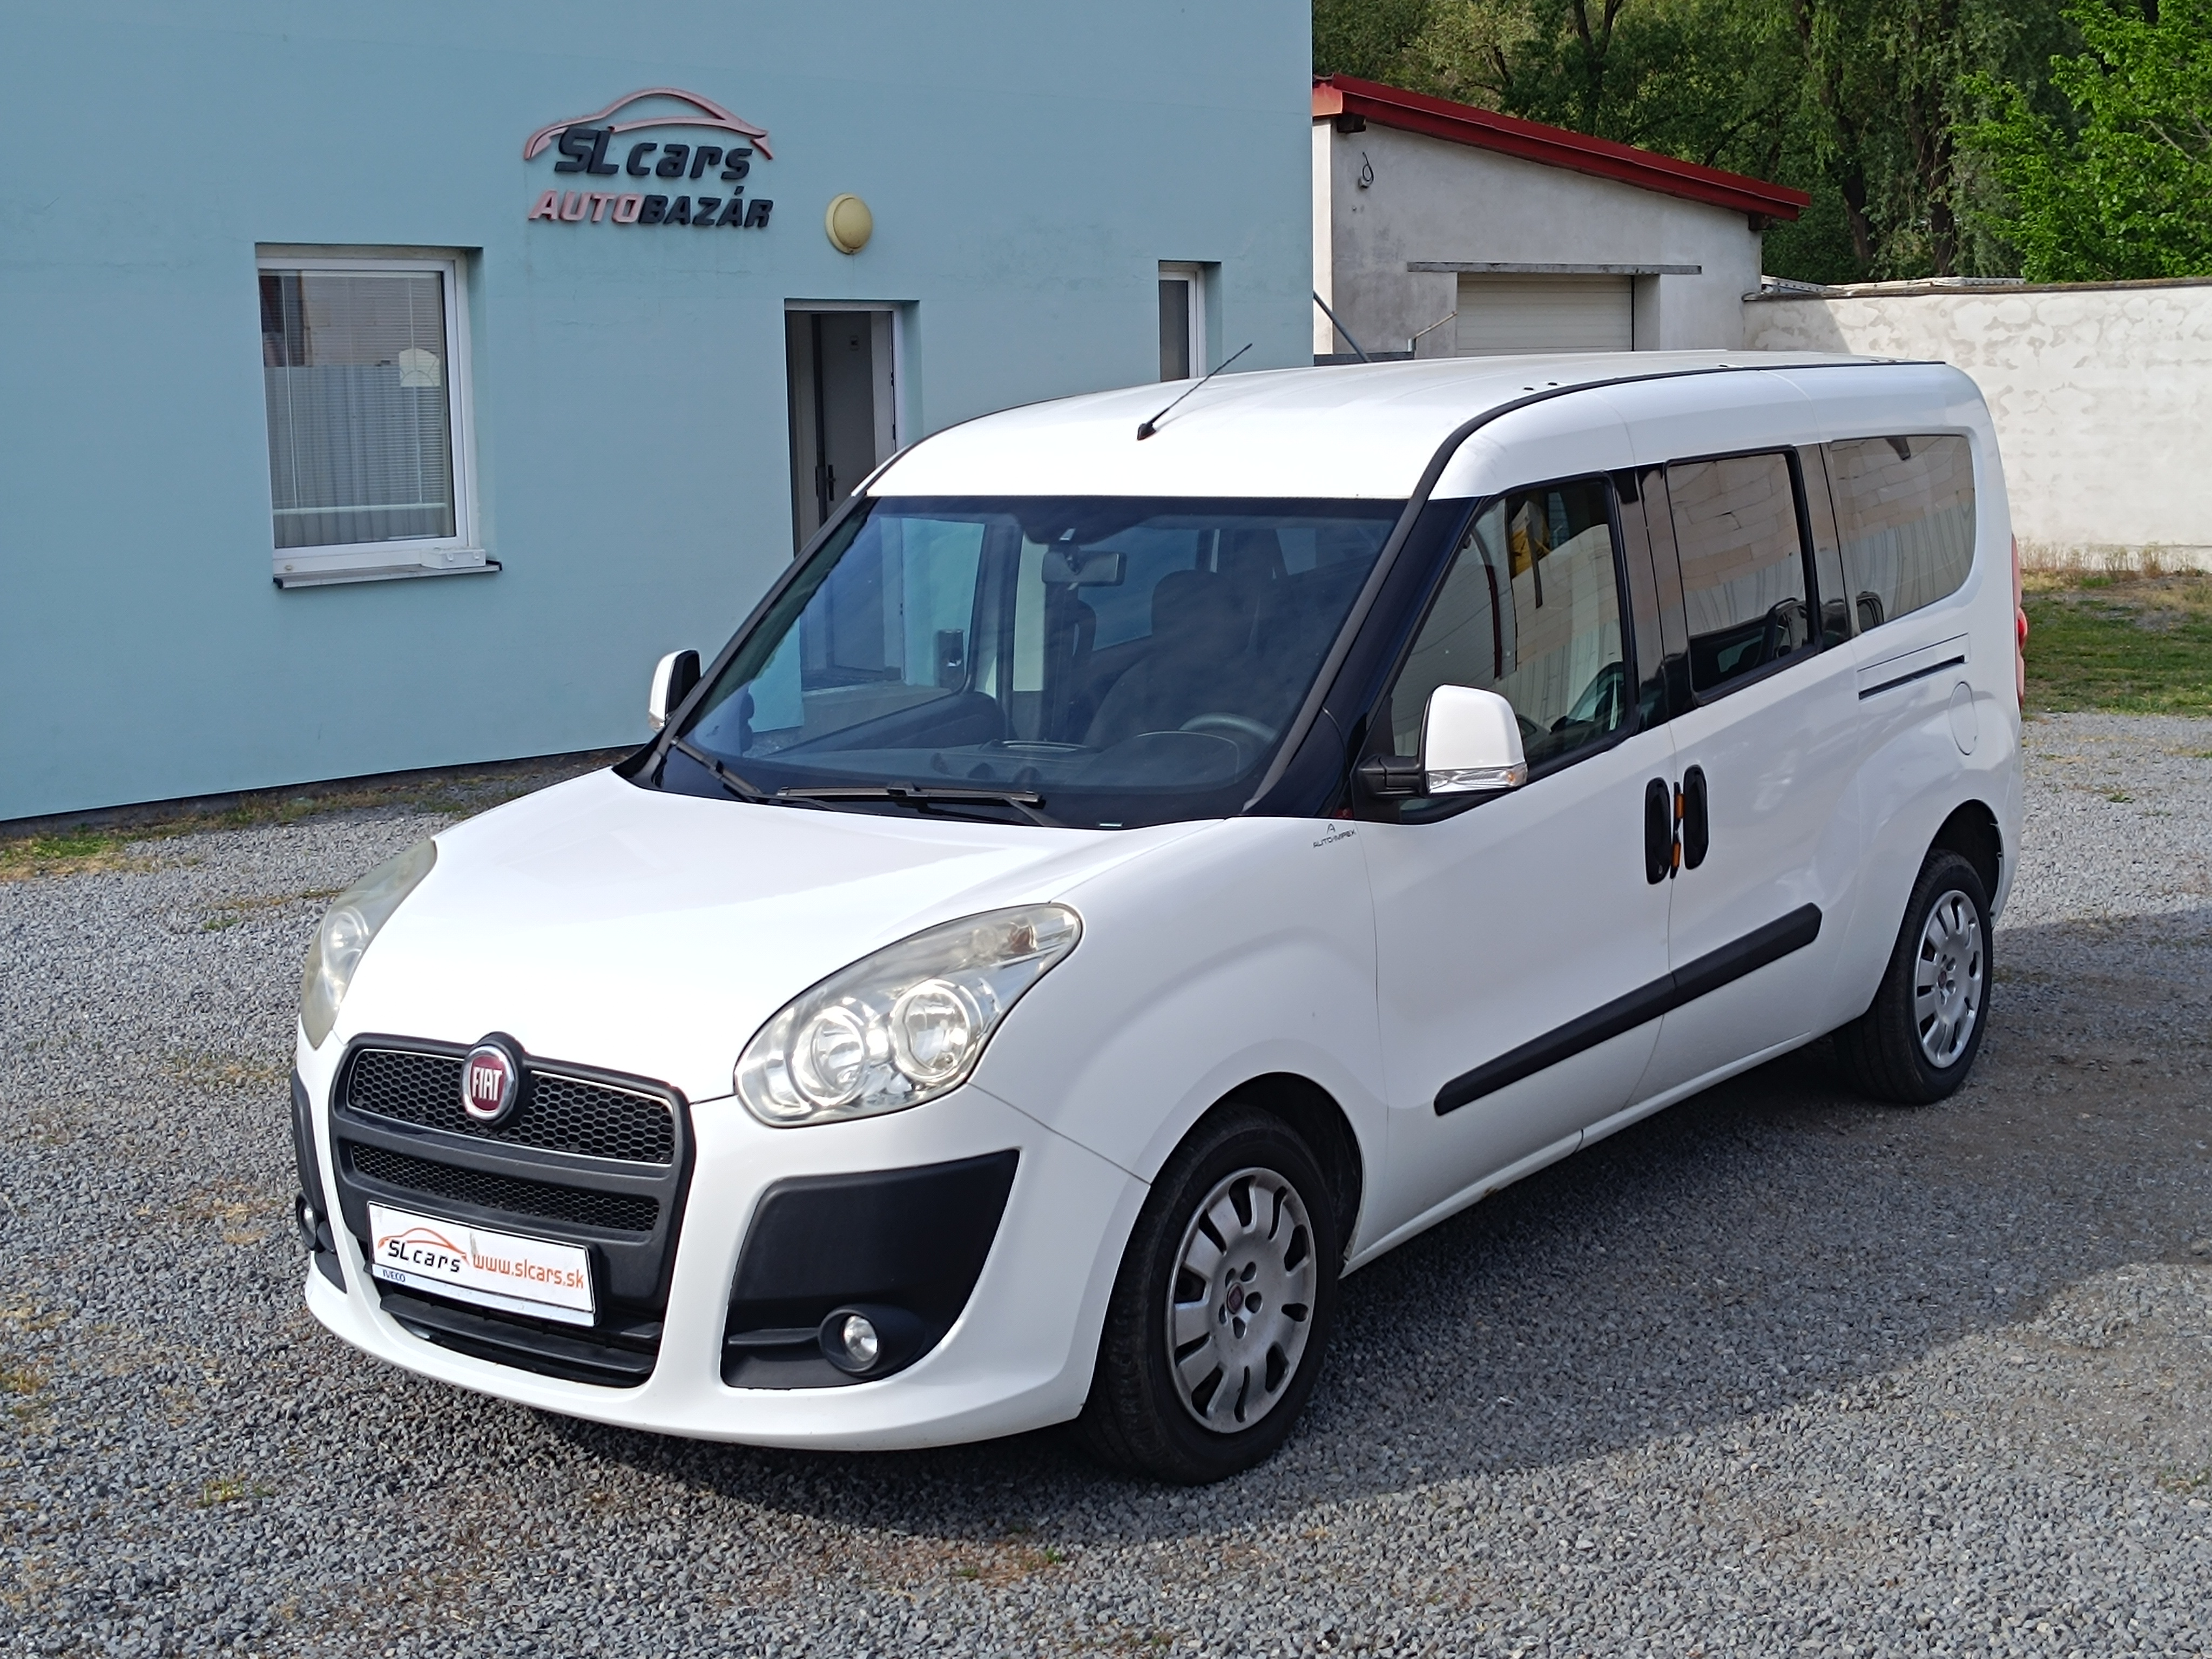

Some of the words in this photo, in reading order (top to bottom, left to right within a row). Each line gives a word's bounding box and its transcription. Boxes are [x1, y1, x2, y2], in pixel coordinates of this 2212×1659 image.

[528, 186, 774, 227] AUTOBAZÁR
[472, 1066, 503, 1101] FIAT
[382, 1269, 406, 1282] IVECO
[473, 1253, 584, 1289] www.slcars.sk
